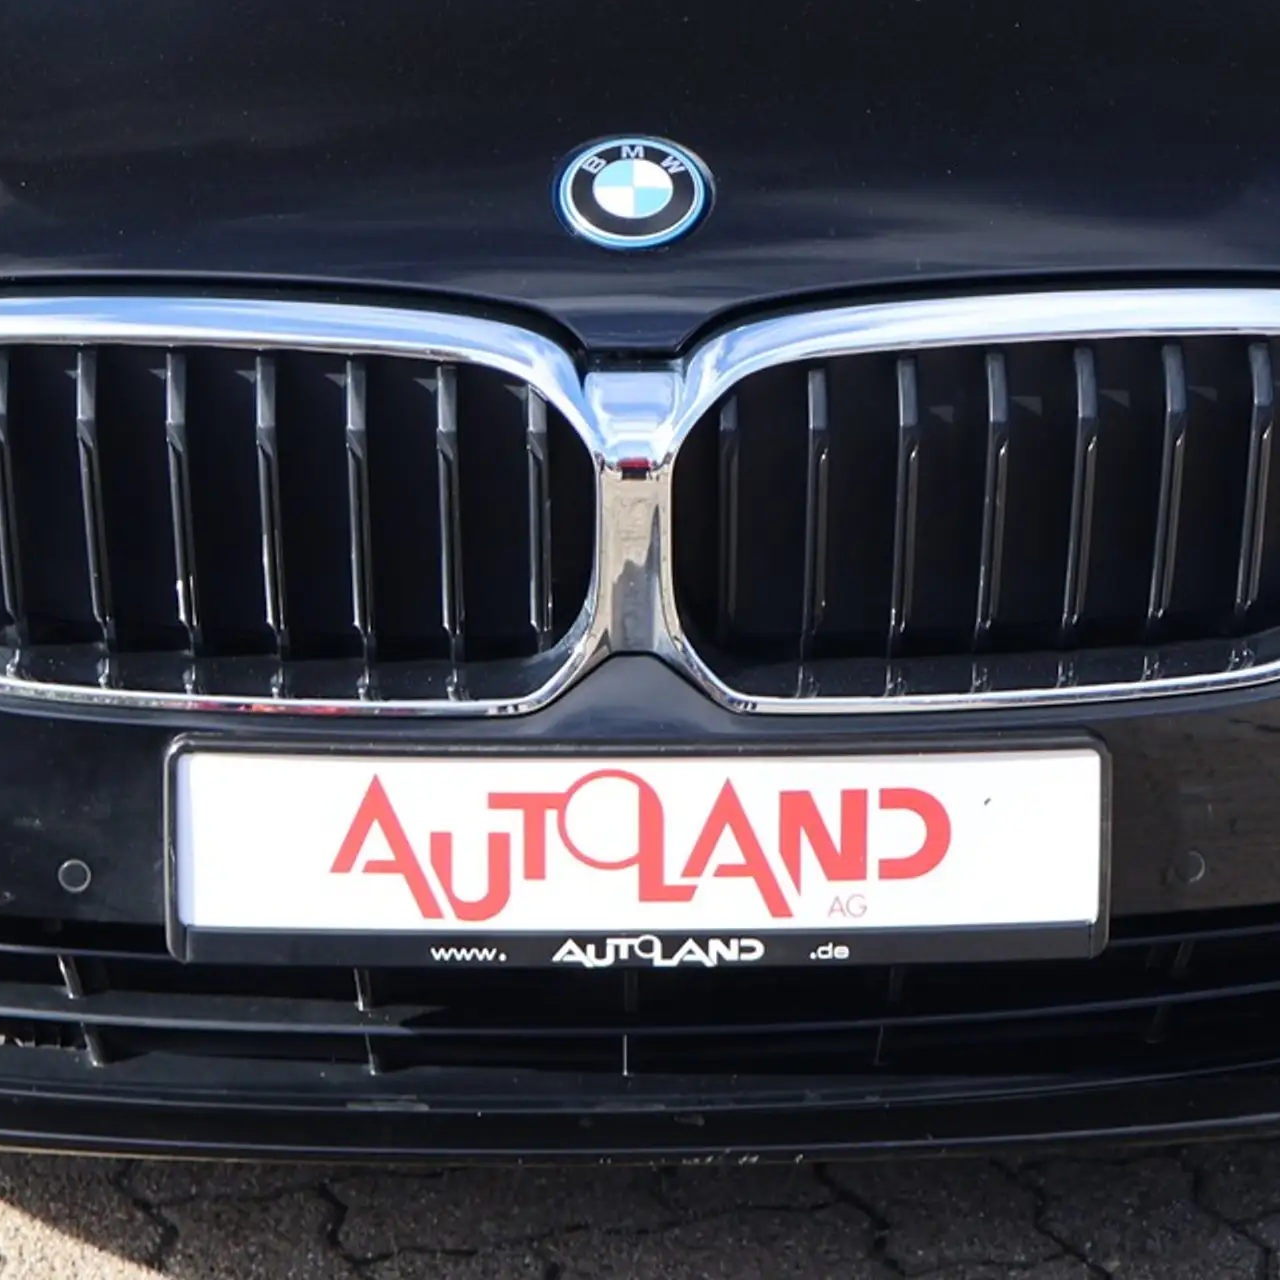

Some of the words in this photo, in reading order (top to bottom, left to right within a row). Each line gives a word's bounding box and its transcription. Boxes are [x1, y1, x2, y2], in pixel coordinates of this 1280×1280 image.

[582, 145, 686, 174] BMW
[330, 769, 952, 922] AUTOLAND
[827, 894, 869, 919] AG
[430, 944, 507, 962] www.
[809, 941, 850, 961] .de
